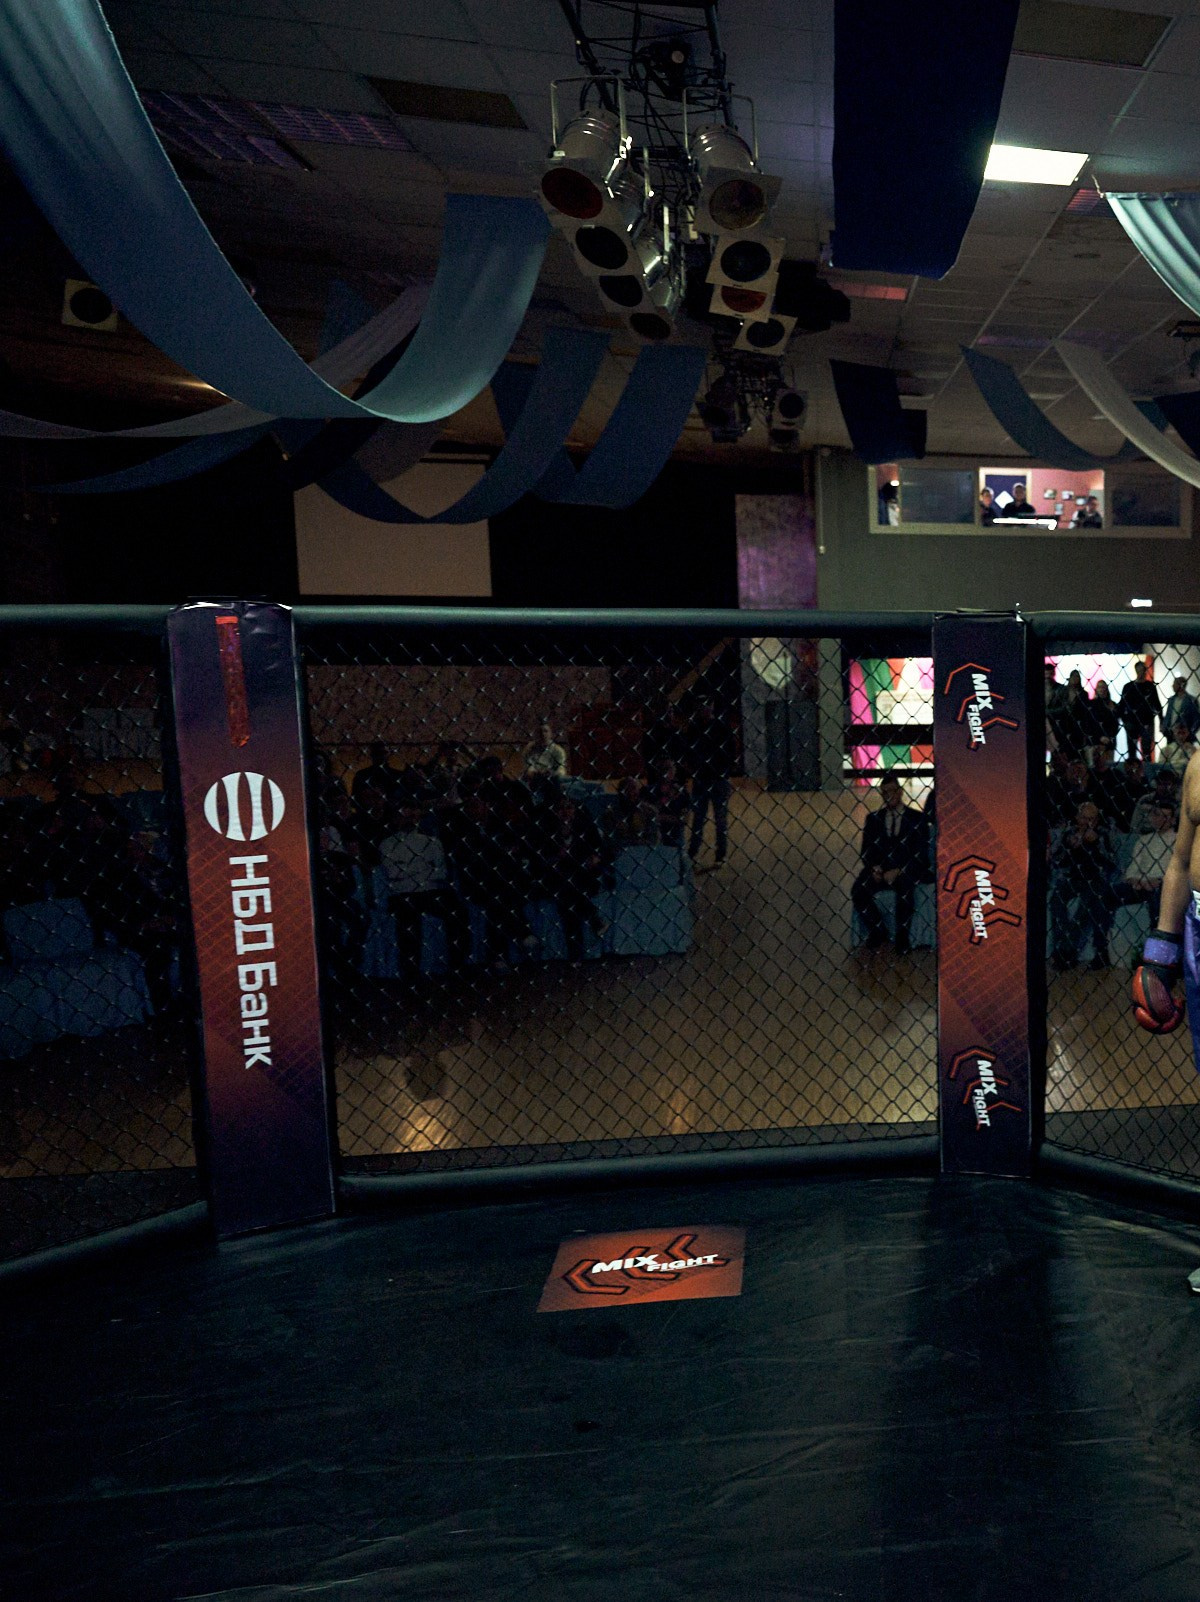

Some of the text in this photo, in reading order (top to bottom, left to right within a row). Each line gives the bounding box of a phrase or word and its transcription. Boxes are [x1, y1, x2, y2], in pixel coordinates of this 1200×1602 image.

[966, 673, 993, 744] MIX FIGHT
[969, 870, 996, 939] MIX FIGHT
[229, 854, 278, 1070] НБД Банк
[972, 1059, 998, 1127] MIX FIGHT
[591, 1254, 719, 1274] MIX FIGHT
